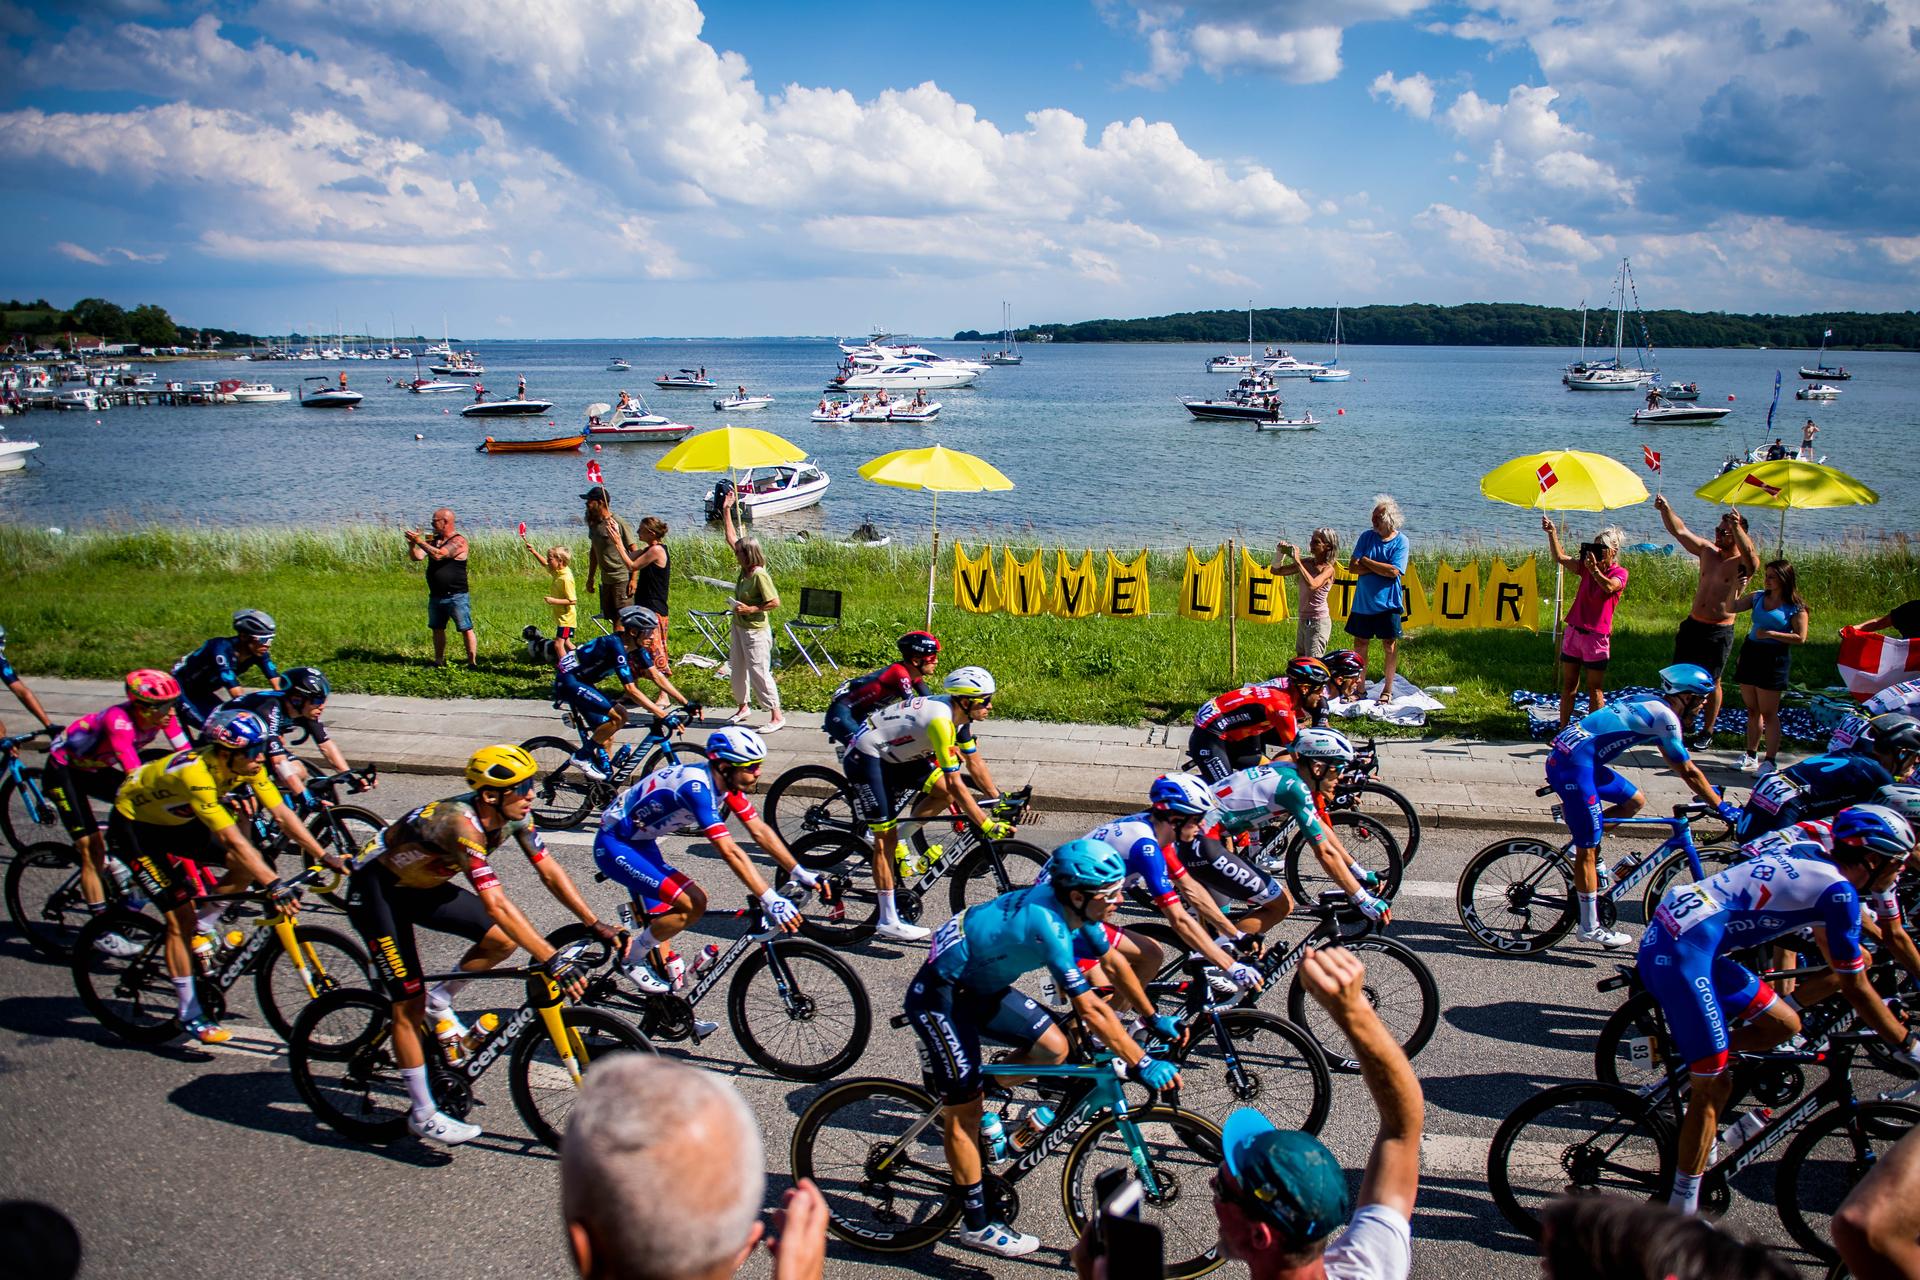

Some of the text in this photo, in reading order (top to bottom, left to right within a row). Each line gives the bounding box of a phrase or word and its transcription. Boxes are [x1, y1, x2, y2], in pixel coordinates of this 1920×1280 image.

[961, 569, 1137, 615] VIVE
[1191, 572, 1273, 616] LE
[1217, 712, 1251, 731] BAHRAIN
[613, 742, 653, 782] CANYON
[1598, 735, 1636, 758] GIANT
[919, 831, 976, 891] CUBE
[1256, 816, 1297, 865] MERID
[614, 855, 660, 889] Groupama
[1212, 855, 1268, 898] BORA
[1611, 847, 1670, 902] GIANT
[1460, 904, 1532, 951] CADEX
[1668, 892, 1704, 920] 93
[1726, 919, 1756, 935] FDJ
[375, 952, 396, 982] VISMA
[377, 935, 408, 979] JUMBO
[1342, 941, 1389, 953] OVAL
[688, 934, 747, 1005] LAPIERRE
[1042, 983, 1054, 998] 91
[1695, 976, 1727, 1050] Groupama
[468, 1006, 535, 1078] cervélo
[930, 1010, 971, 1079] ASTANA
[1633, 1044, 1649, 1060] 93
[1018, 1104, 1092, 1172] Wilier
[1724, 1097, 1820, 1181] LAPIERRE
[828, 1208, 895, 1241] CORI
